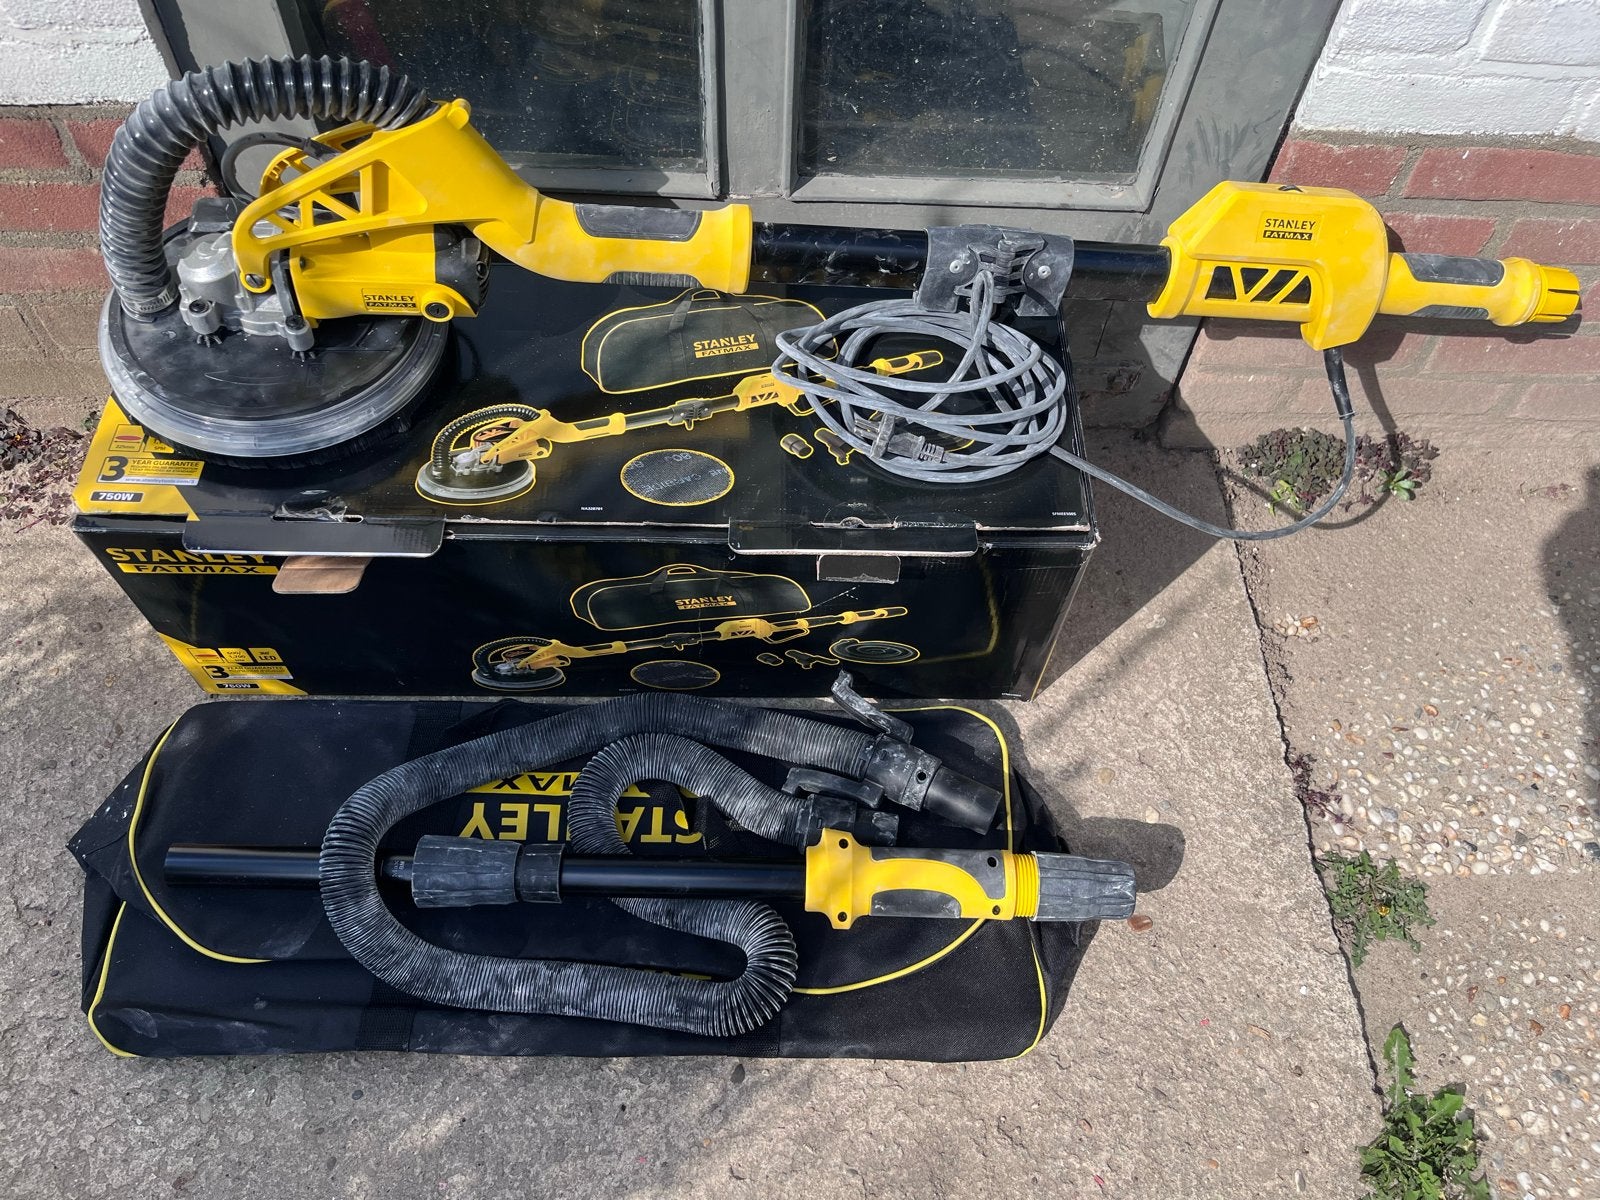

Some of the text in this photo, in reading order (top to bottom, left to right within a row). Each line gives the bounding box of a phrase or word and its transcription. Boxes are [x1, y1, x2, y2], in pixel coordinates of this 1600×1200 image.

[1265, 218, 1316, 230] STANLEY
[1265, 231, 1310, 240] FATMAX
[364, 294, 415, 302] STANLEY
[693, 334, 756, 351] STANLEY
[701, 345, 751, 357] FATMAX
[99, 455, 128, 482] 3
[98, 492, 135, 501] 750W
[105, 547, 266, 564] STANLEY
[132, 565, 259, 574] FATMAX
[674, 595, 733, 606] STANLEY
[203, 665, 230, 679] 3
[459, 802, 703, 844] STALEY
